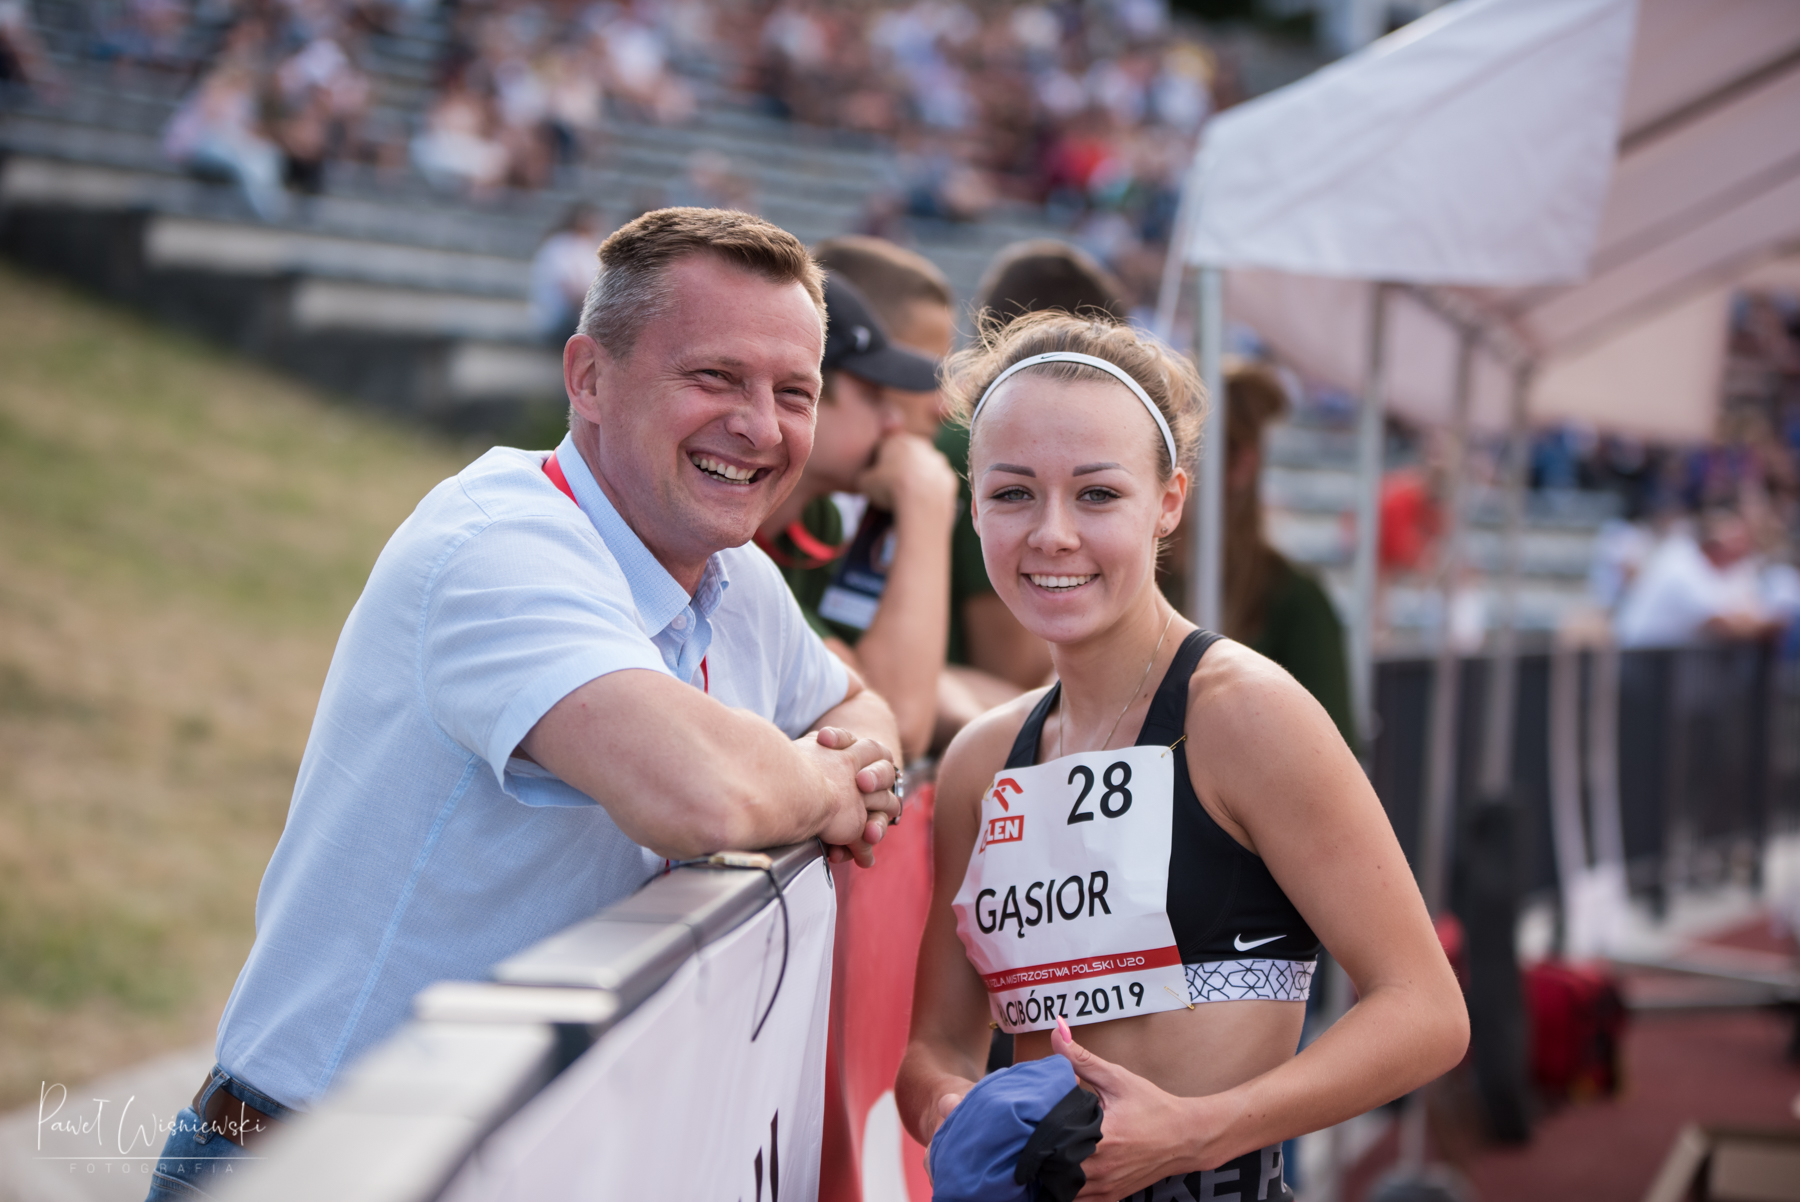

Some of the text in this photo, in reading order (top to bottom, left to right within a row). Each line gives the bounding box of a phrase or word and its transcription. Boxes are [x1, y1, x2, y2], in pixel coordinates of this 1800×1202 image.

[1067, 761, 1133, 825] 28
[981, 817, 1022, 851] LEN
[975, 870, 1112, 938] GĄSIOR
[1072, 960, 1114, 975] POLSKI
[1117, 956, 1145, 968] U20
[1074, 982, 1145, 1017] 2019
